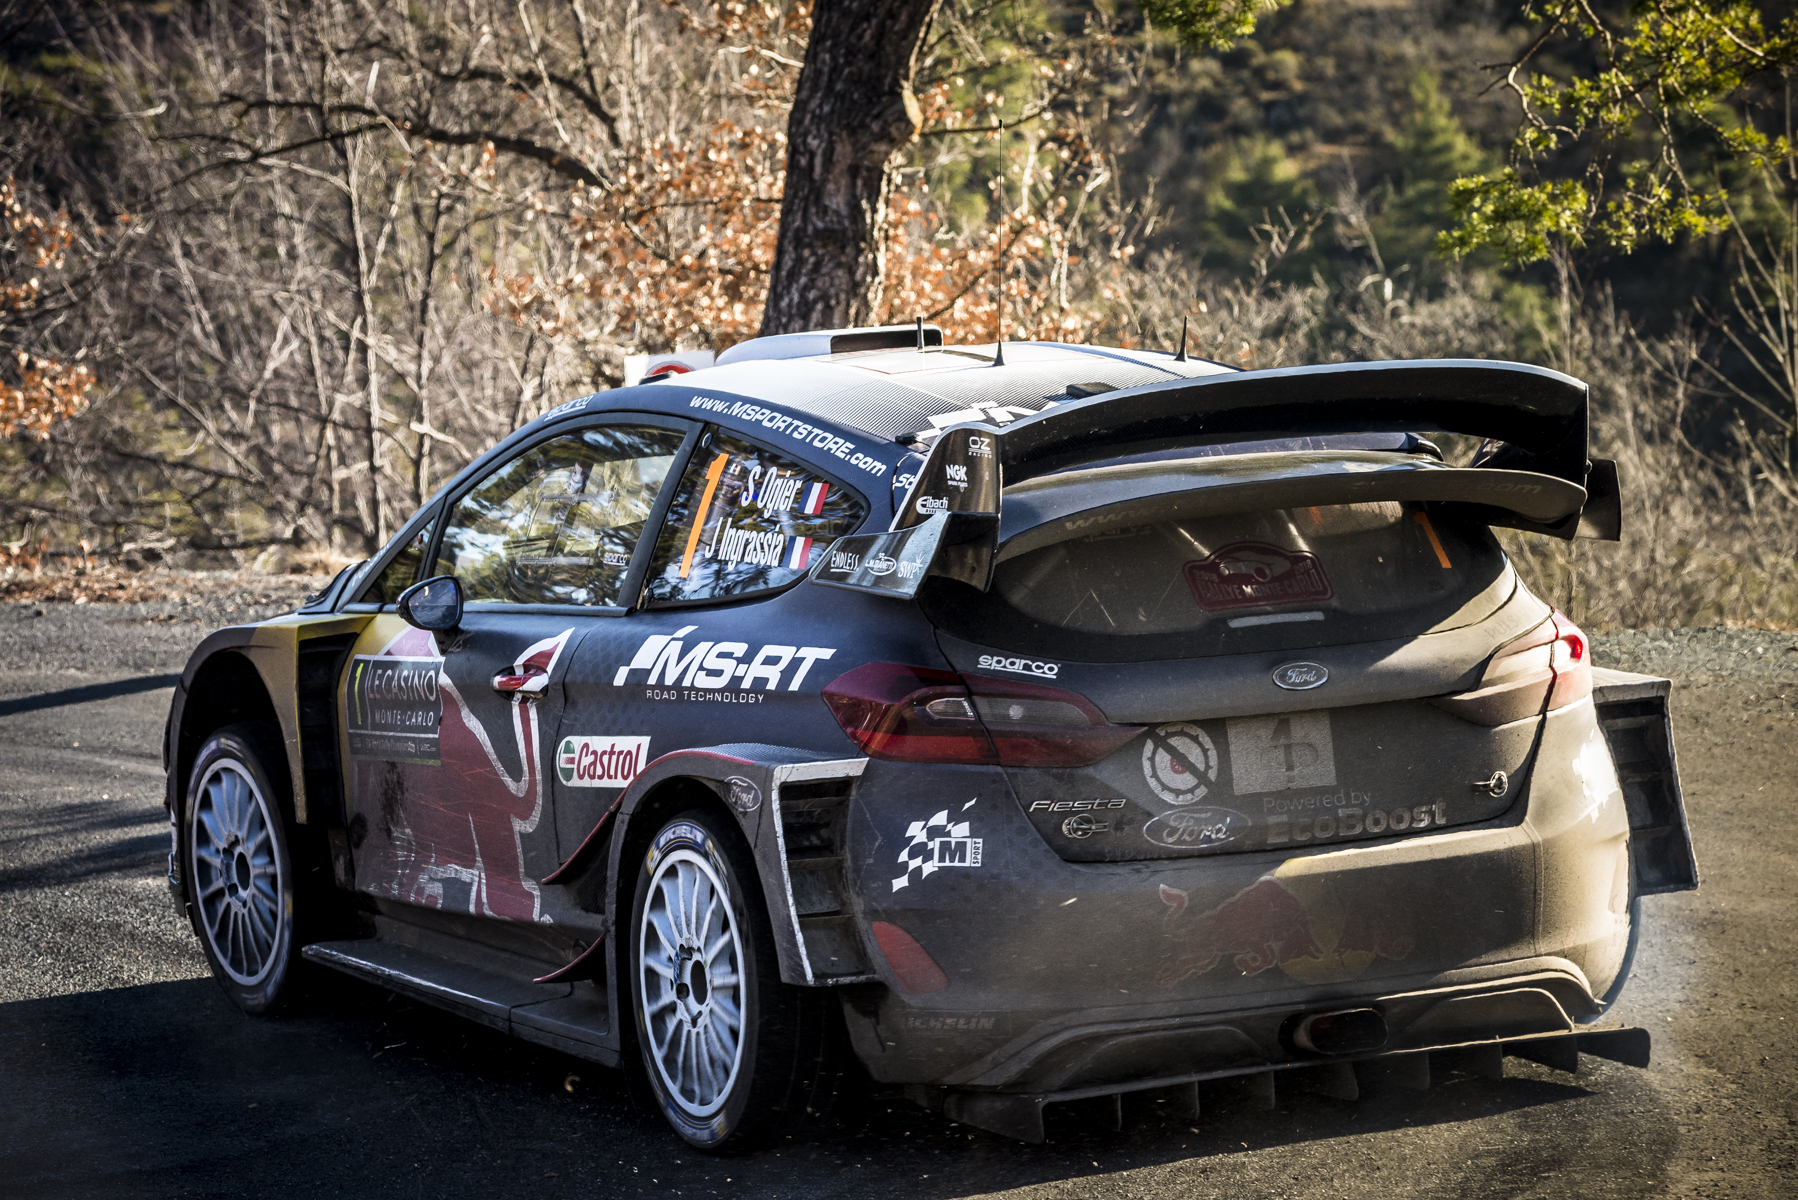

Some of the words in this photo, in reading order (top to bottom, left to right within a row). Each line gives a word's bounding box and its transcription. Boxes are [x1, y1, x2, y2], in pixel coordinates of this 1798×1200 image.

[689, 395, 887, 477] www.MSPORTSTORE.com
[969, 436, 991, 450] OZ
[946, 464, 968, 482] NGK
[741, 465, 762, 507] S
[757, 466, 803, 518] Ogier
[679, 453, 729, 578] 1
[915, 495, 949, 515] Eibach
[705, 517, 724, 558] J
[718, 517, 785, 571] Ingrassia
[603, 552, 628, 564] sparco
[979, 655, 1059, 675] sparco
[1286, 667, 1317, 683] Ford
[646, 690, 677, 701] ROAD
[683, 691, 764, 704] TECHNOLOGY
[576, 742, 642, 781] Castrol
[730, 780, 755, 807] Ford
[1029, 798, 1127, 812] Fiesta
[1263, 788, 1346, 813] Powered
[1351, 789, 1371, 806] by
[1162, 811, 1234, 844] Ford
[1267, 798, 1448, 843] EcoBoost
[972, 840, 982, 865] SPORT
